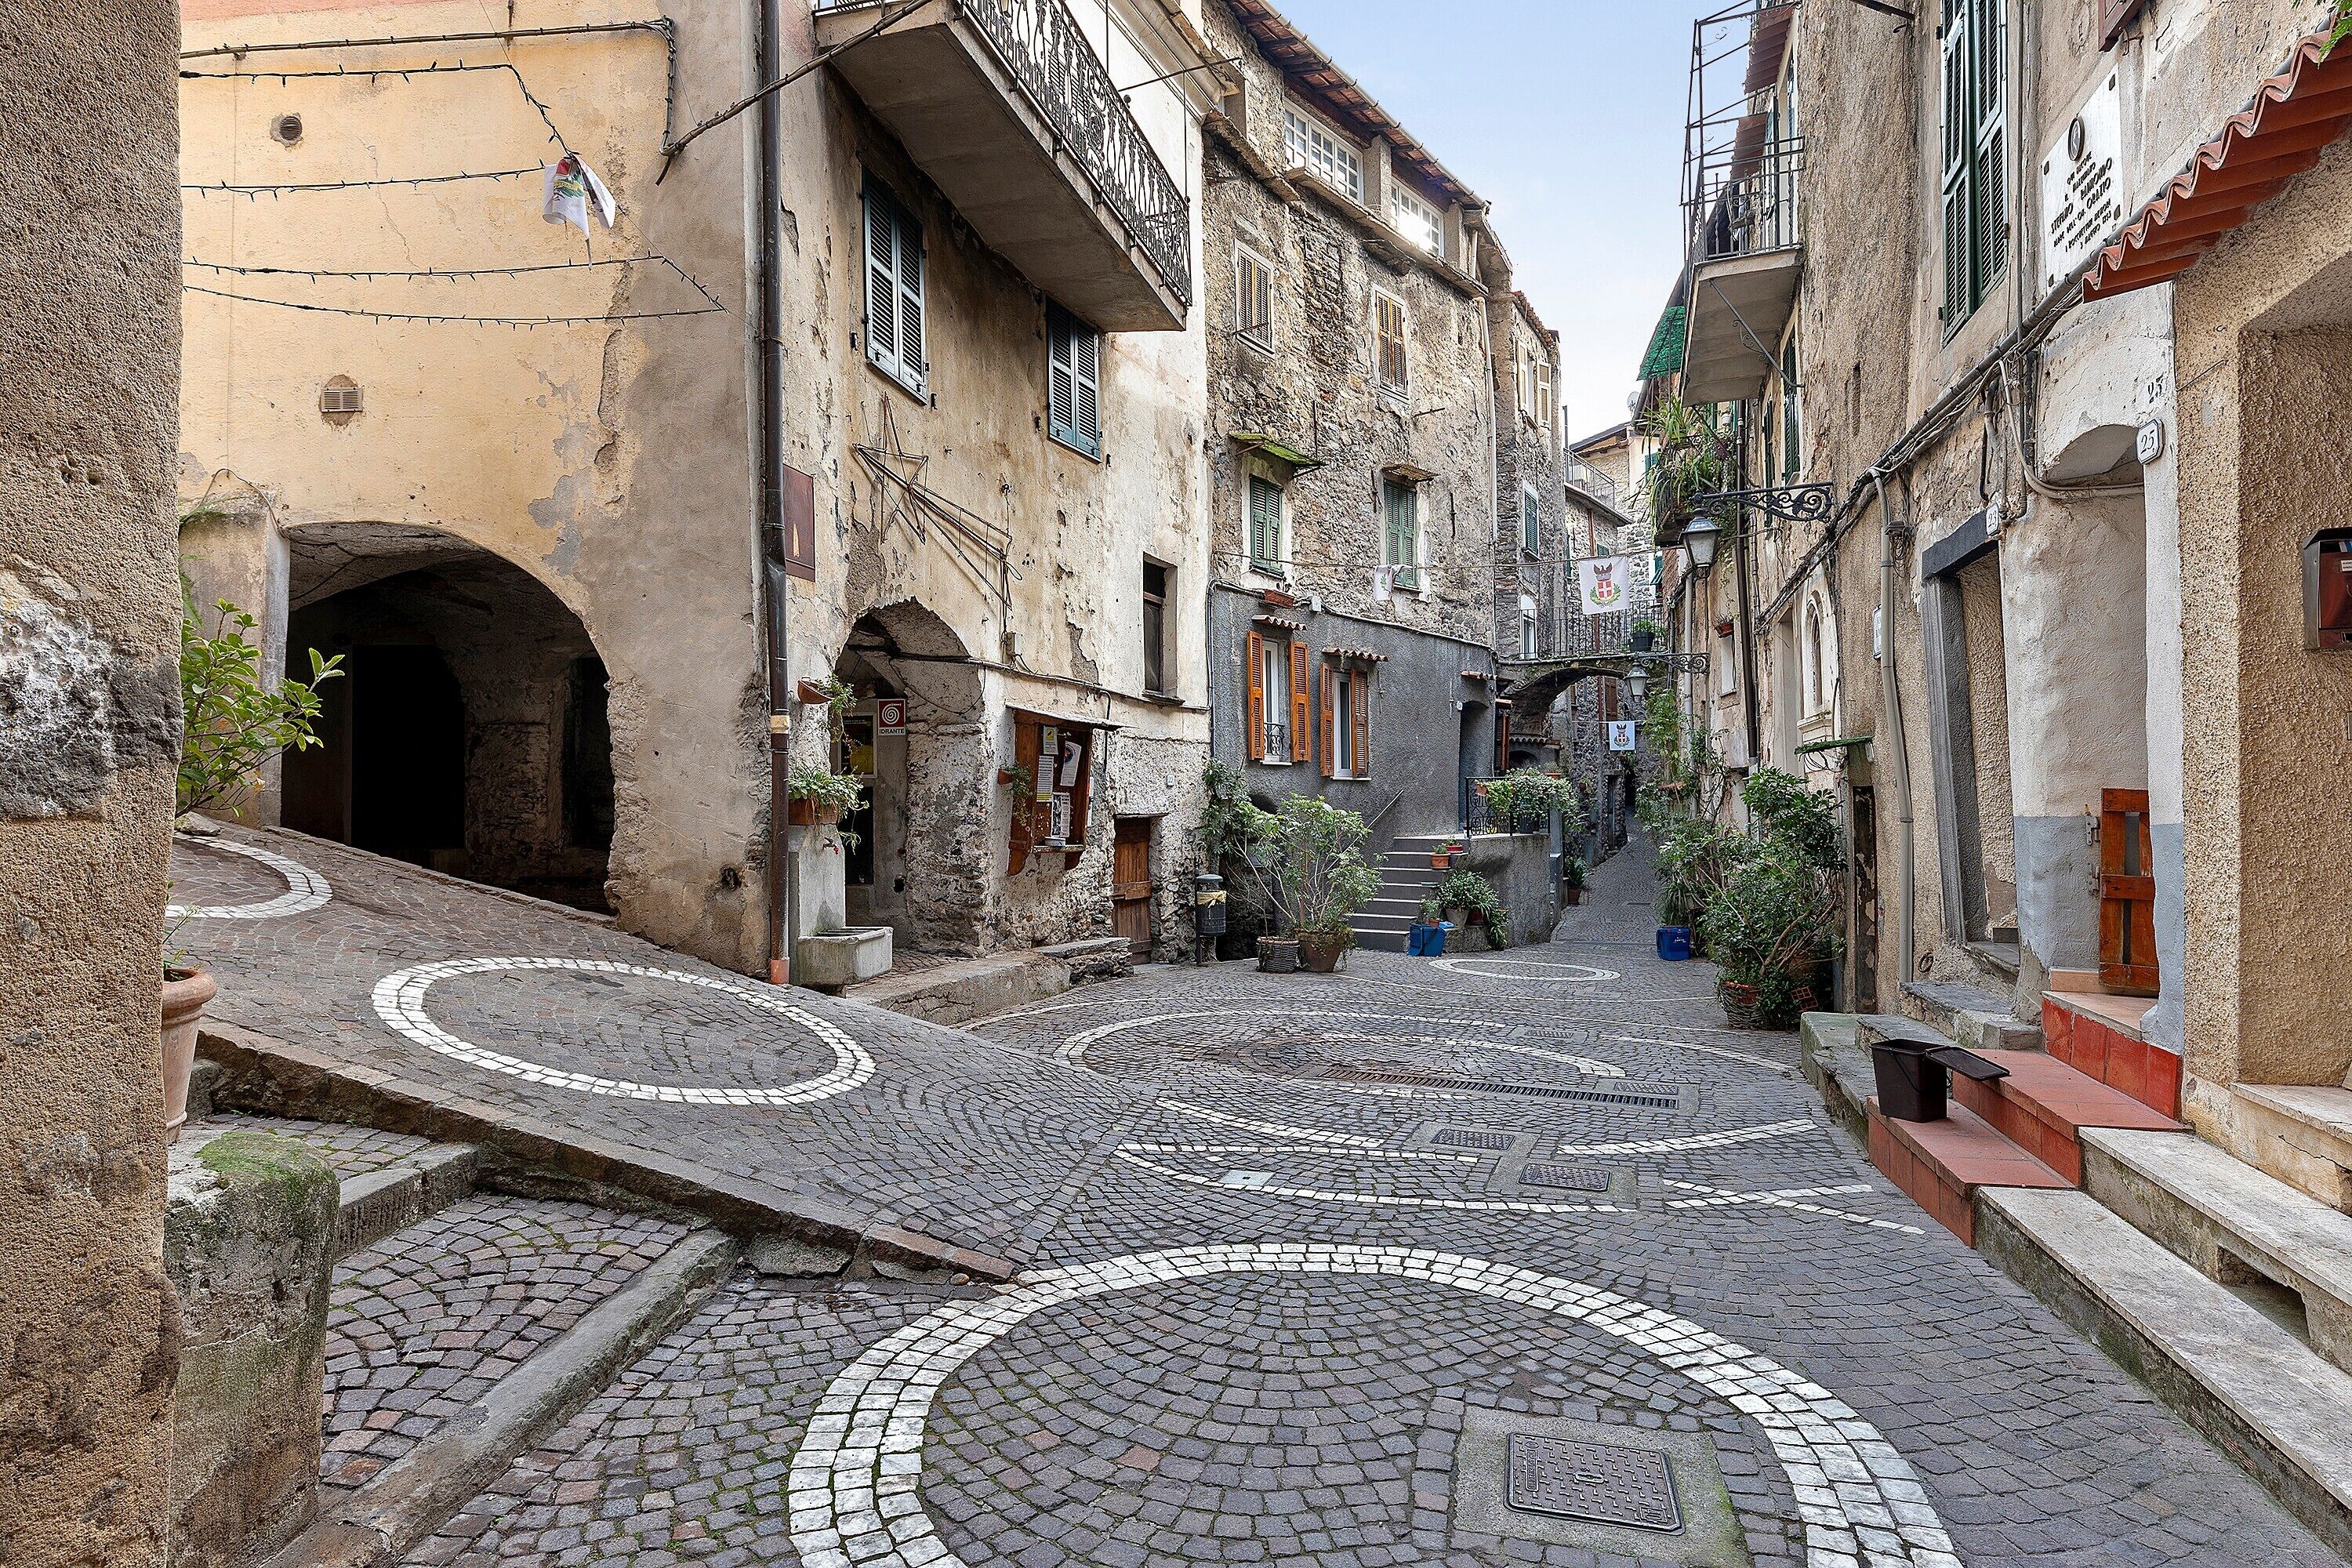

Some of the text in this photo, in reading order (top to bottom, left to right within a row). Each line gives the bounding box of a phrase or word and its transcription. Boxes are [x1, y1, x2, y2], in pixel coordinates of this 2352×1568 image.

[2051, 157, 2112, 234] STEFANO RAIMONDO
[2086, 176, 2111, 209] ORAZIO
[2140, 430, 2154, 454] 25
[1987, 510, 1997, 528] 23
